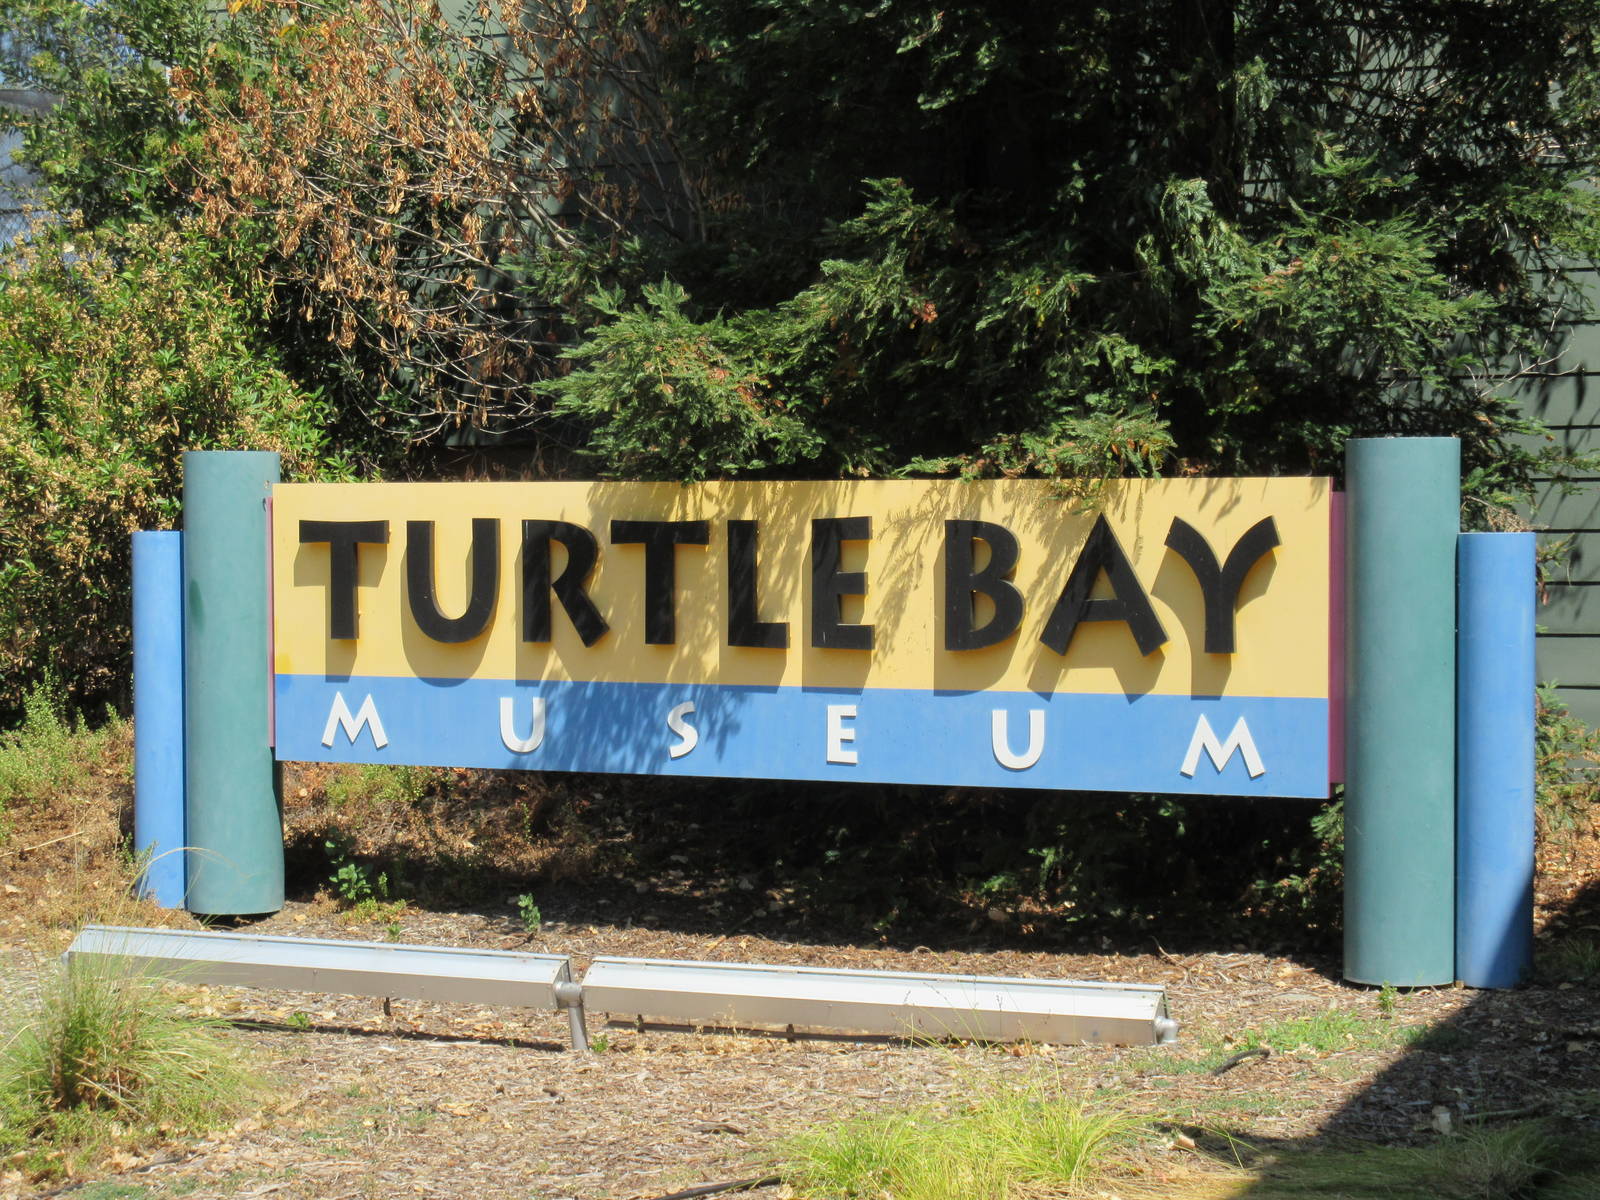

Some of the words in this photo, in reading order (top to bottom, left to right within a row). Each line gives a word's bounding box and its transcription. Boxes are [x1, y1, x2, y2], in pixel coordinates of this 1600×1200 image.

[299, 516, 875, 650] TURTLE
[944, 512, 1283, 656] BAY
[321, 691, 1265, 778] MUSEUM
